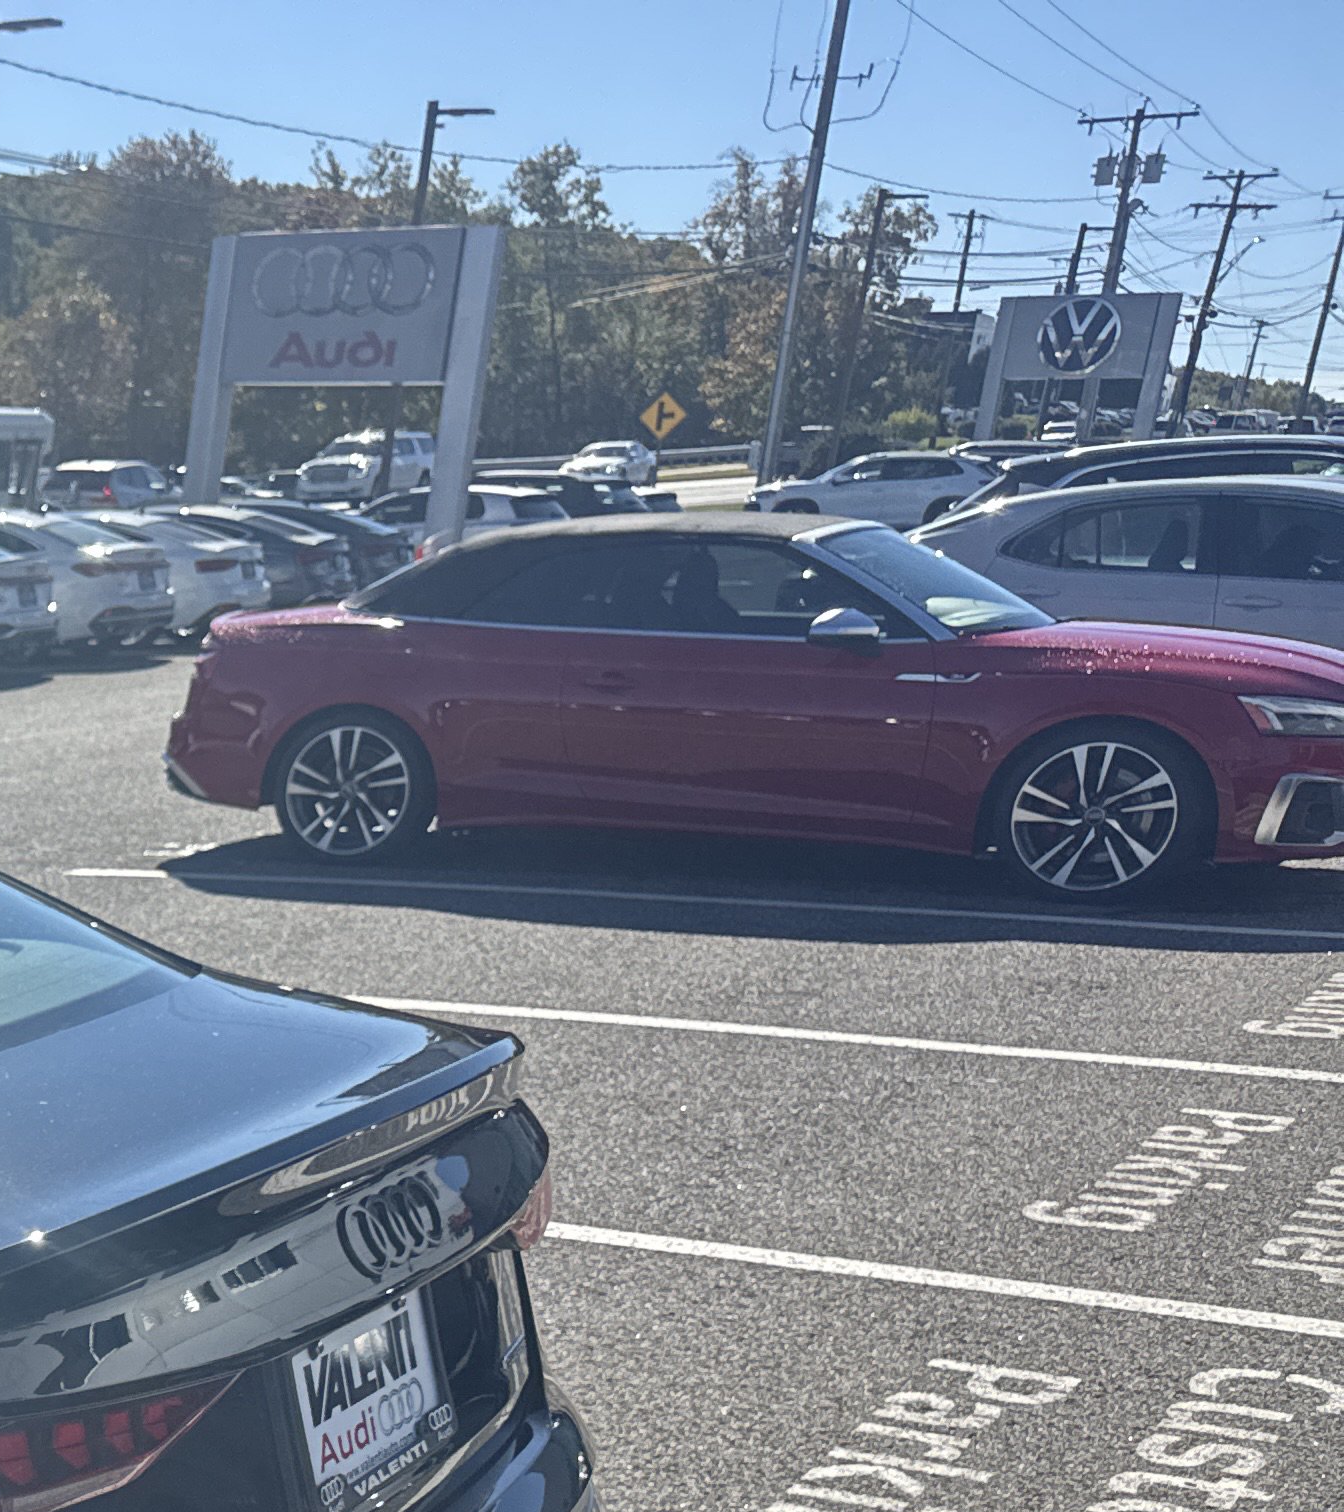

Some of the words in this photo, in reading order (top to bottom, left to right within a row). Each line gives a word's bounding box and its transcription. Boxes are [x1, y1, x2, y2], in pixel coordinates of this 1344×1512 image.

[269, 331, 398, 370] Audi
[1023, 1107, 1295, 1232] Parking
[303, 1310, 418, 1428] VALENTI
[320, 1406, 377, 1474] Audi
[354, 1440, 428, 1496] VALENTI
